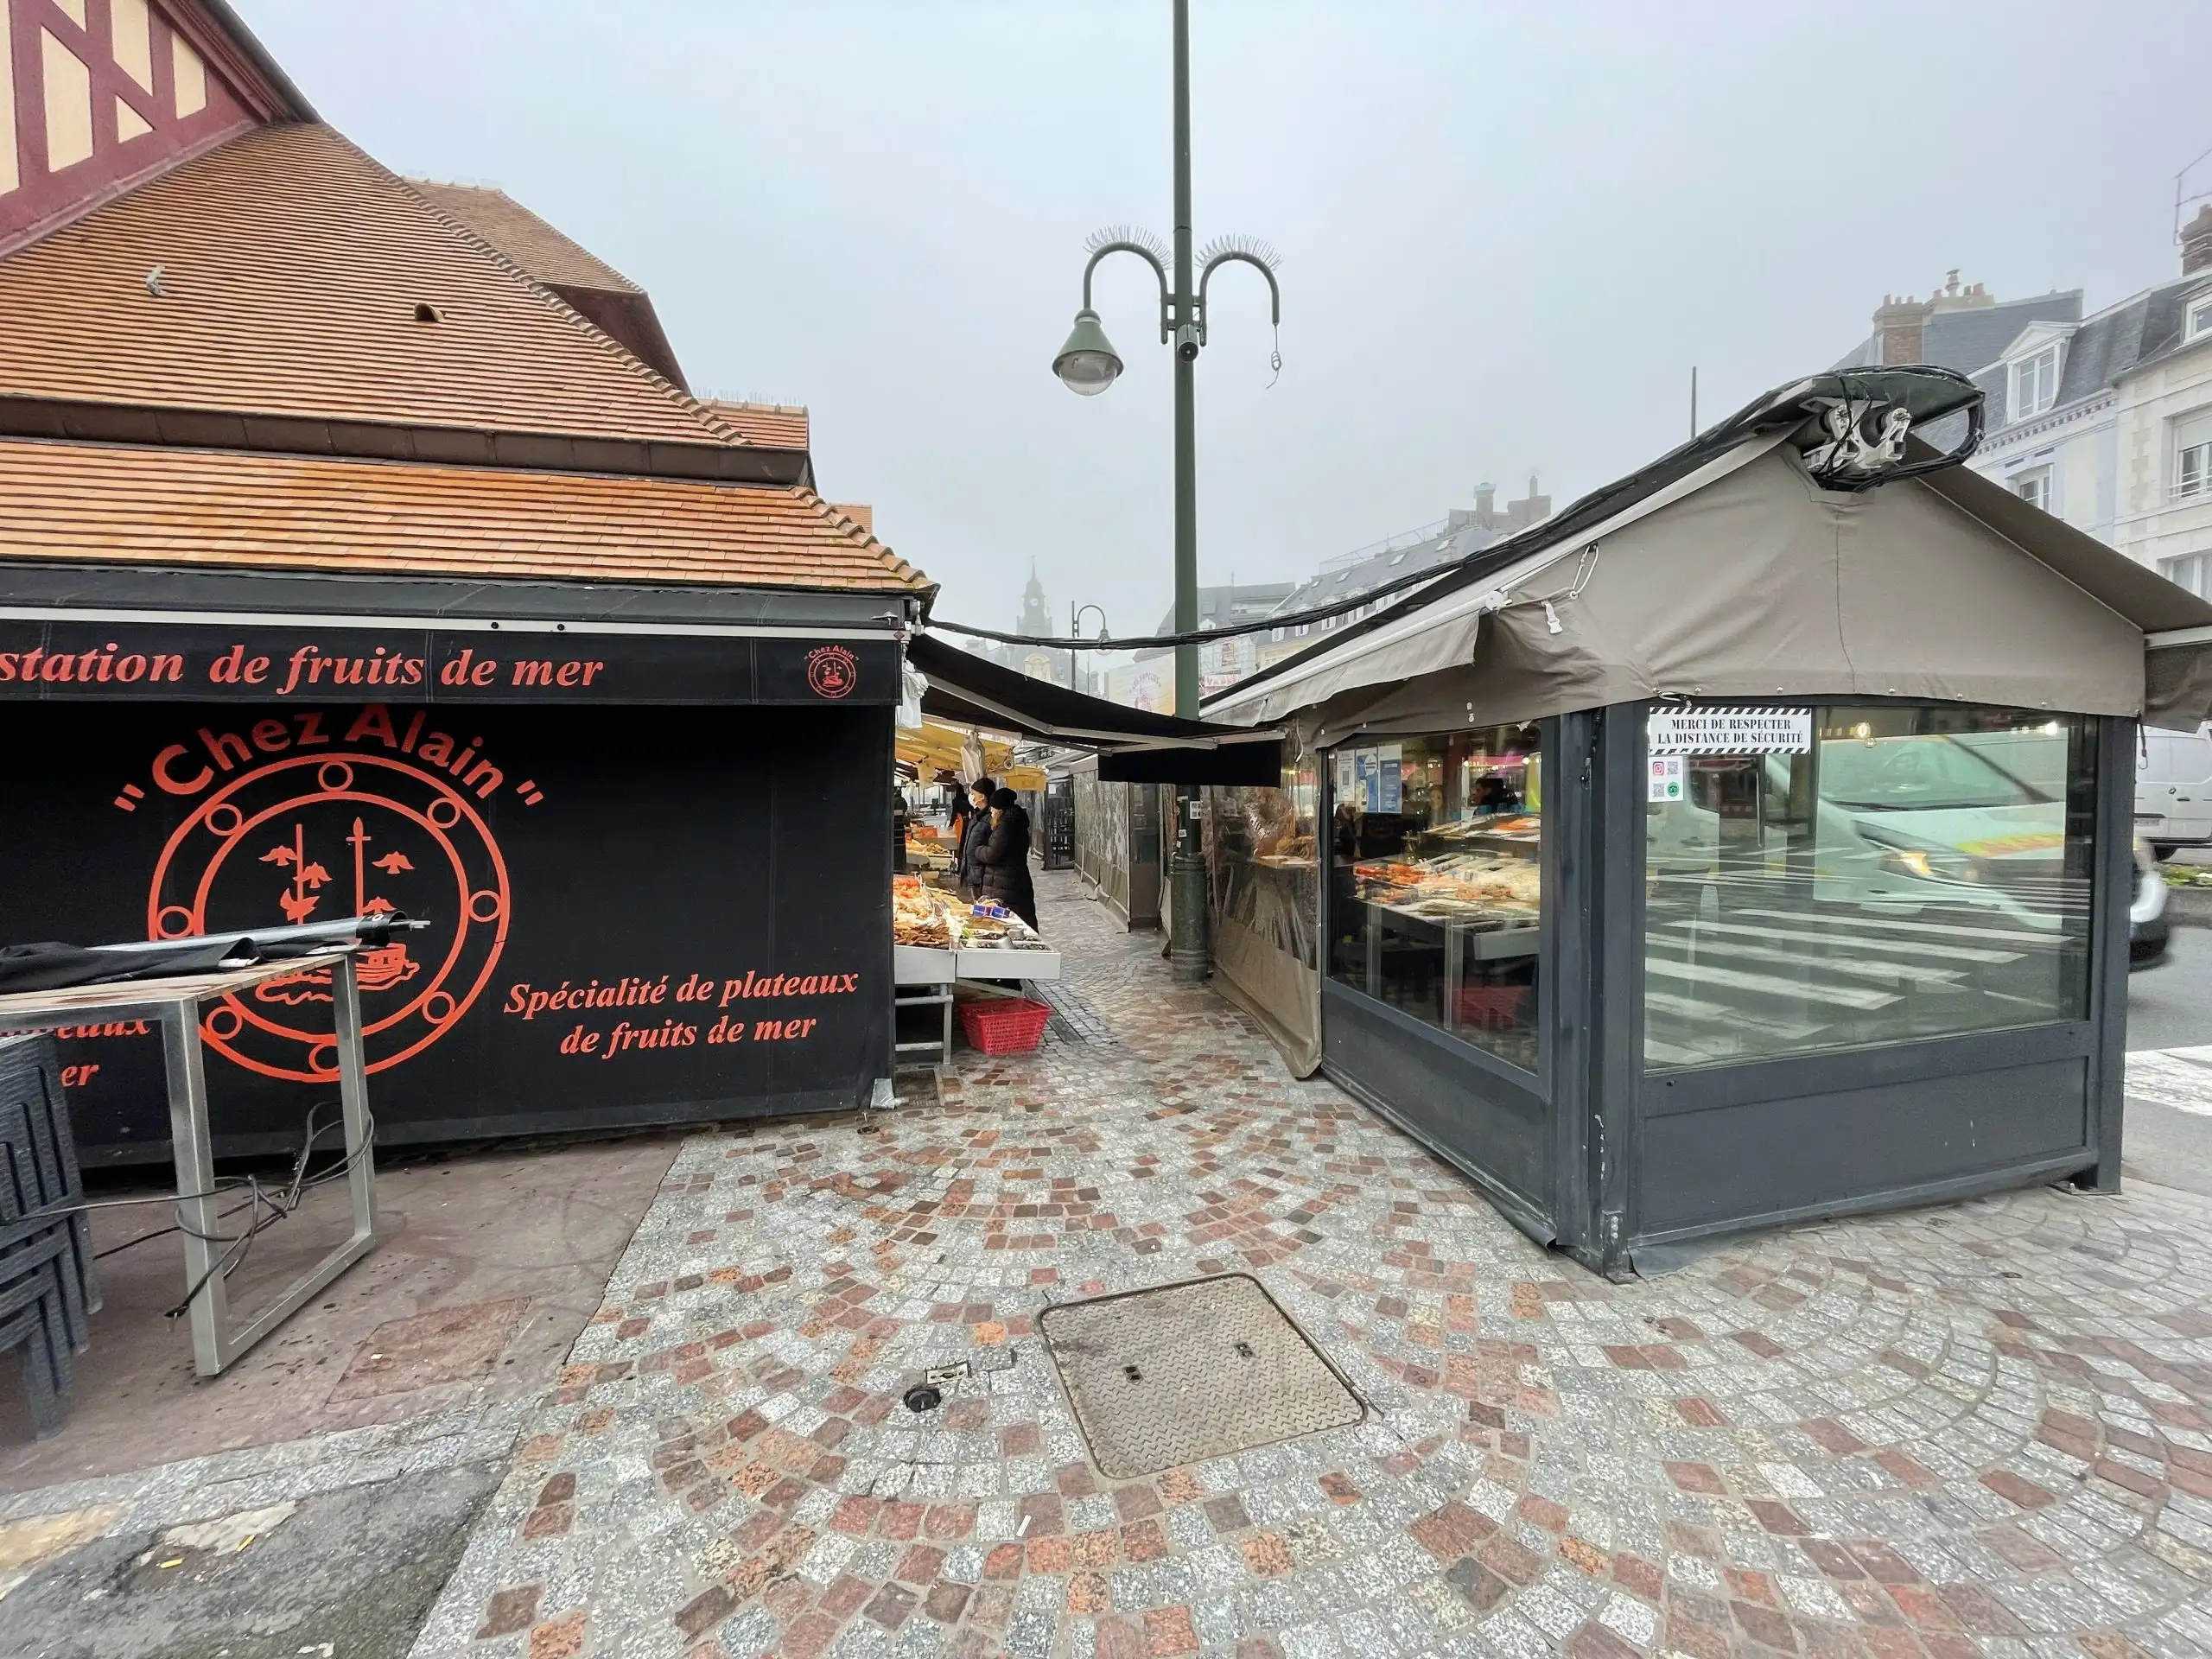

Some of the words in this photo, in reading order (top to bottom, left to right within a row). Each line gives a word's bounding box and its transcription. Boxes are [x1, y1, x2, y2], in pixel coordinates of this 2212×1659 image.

[209, 645, 270, 684] de
[276, 646, 425, 695] fruits
[440, 648, 497, 686] de
[512, 659, 604, 687] mer
[1657, 734, 1671, 744] LA
[1675, 733, 1729, 744] DISTANCE
[1733, 733, 1747, 743] DE
[1751, 730, 1803, 743] SÉCURITÉ
[1671, 719, 1707, 730] MERCI
[1711, 719, 1726, 730] DE
[1729, 719, 1791, 730] RESPECTER
[504, 975, 670, 1020] Spécialité
[676, 973, 713, 1003] de
[719, 969, 859, 1008] plateaux
[560, 1024, 600, 1055] de
[601, 1019, 698, 1059] fruits
[707, 1014, 745, 1045] de
[753, 1016, 817, 1042] mer
